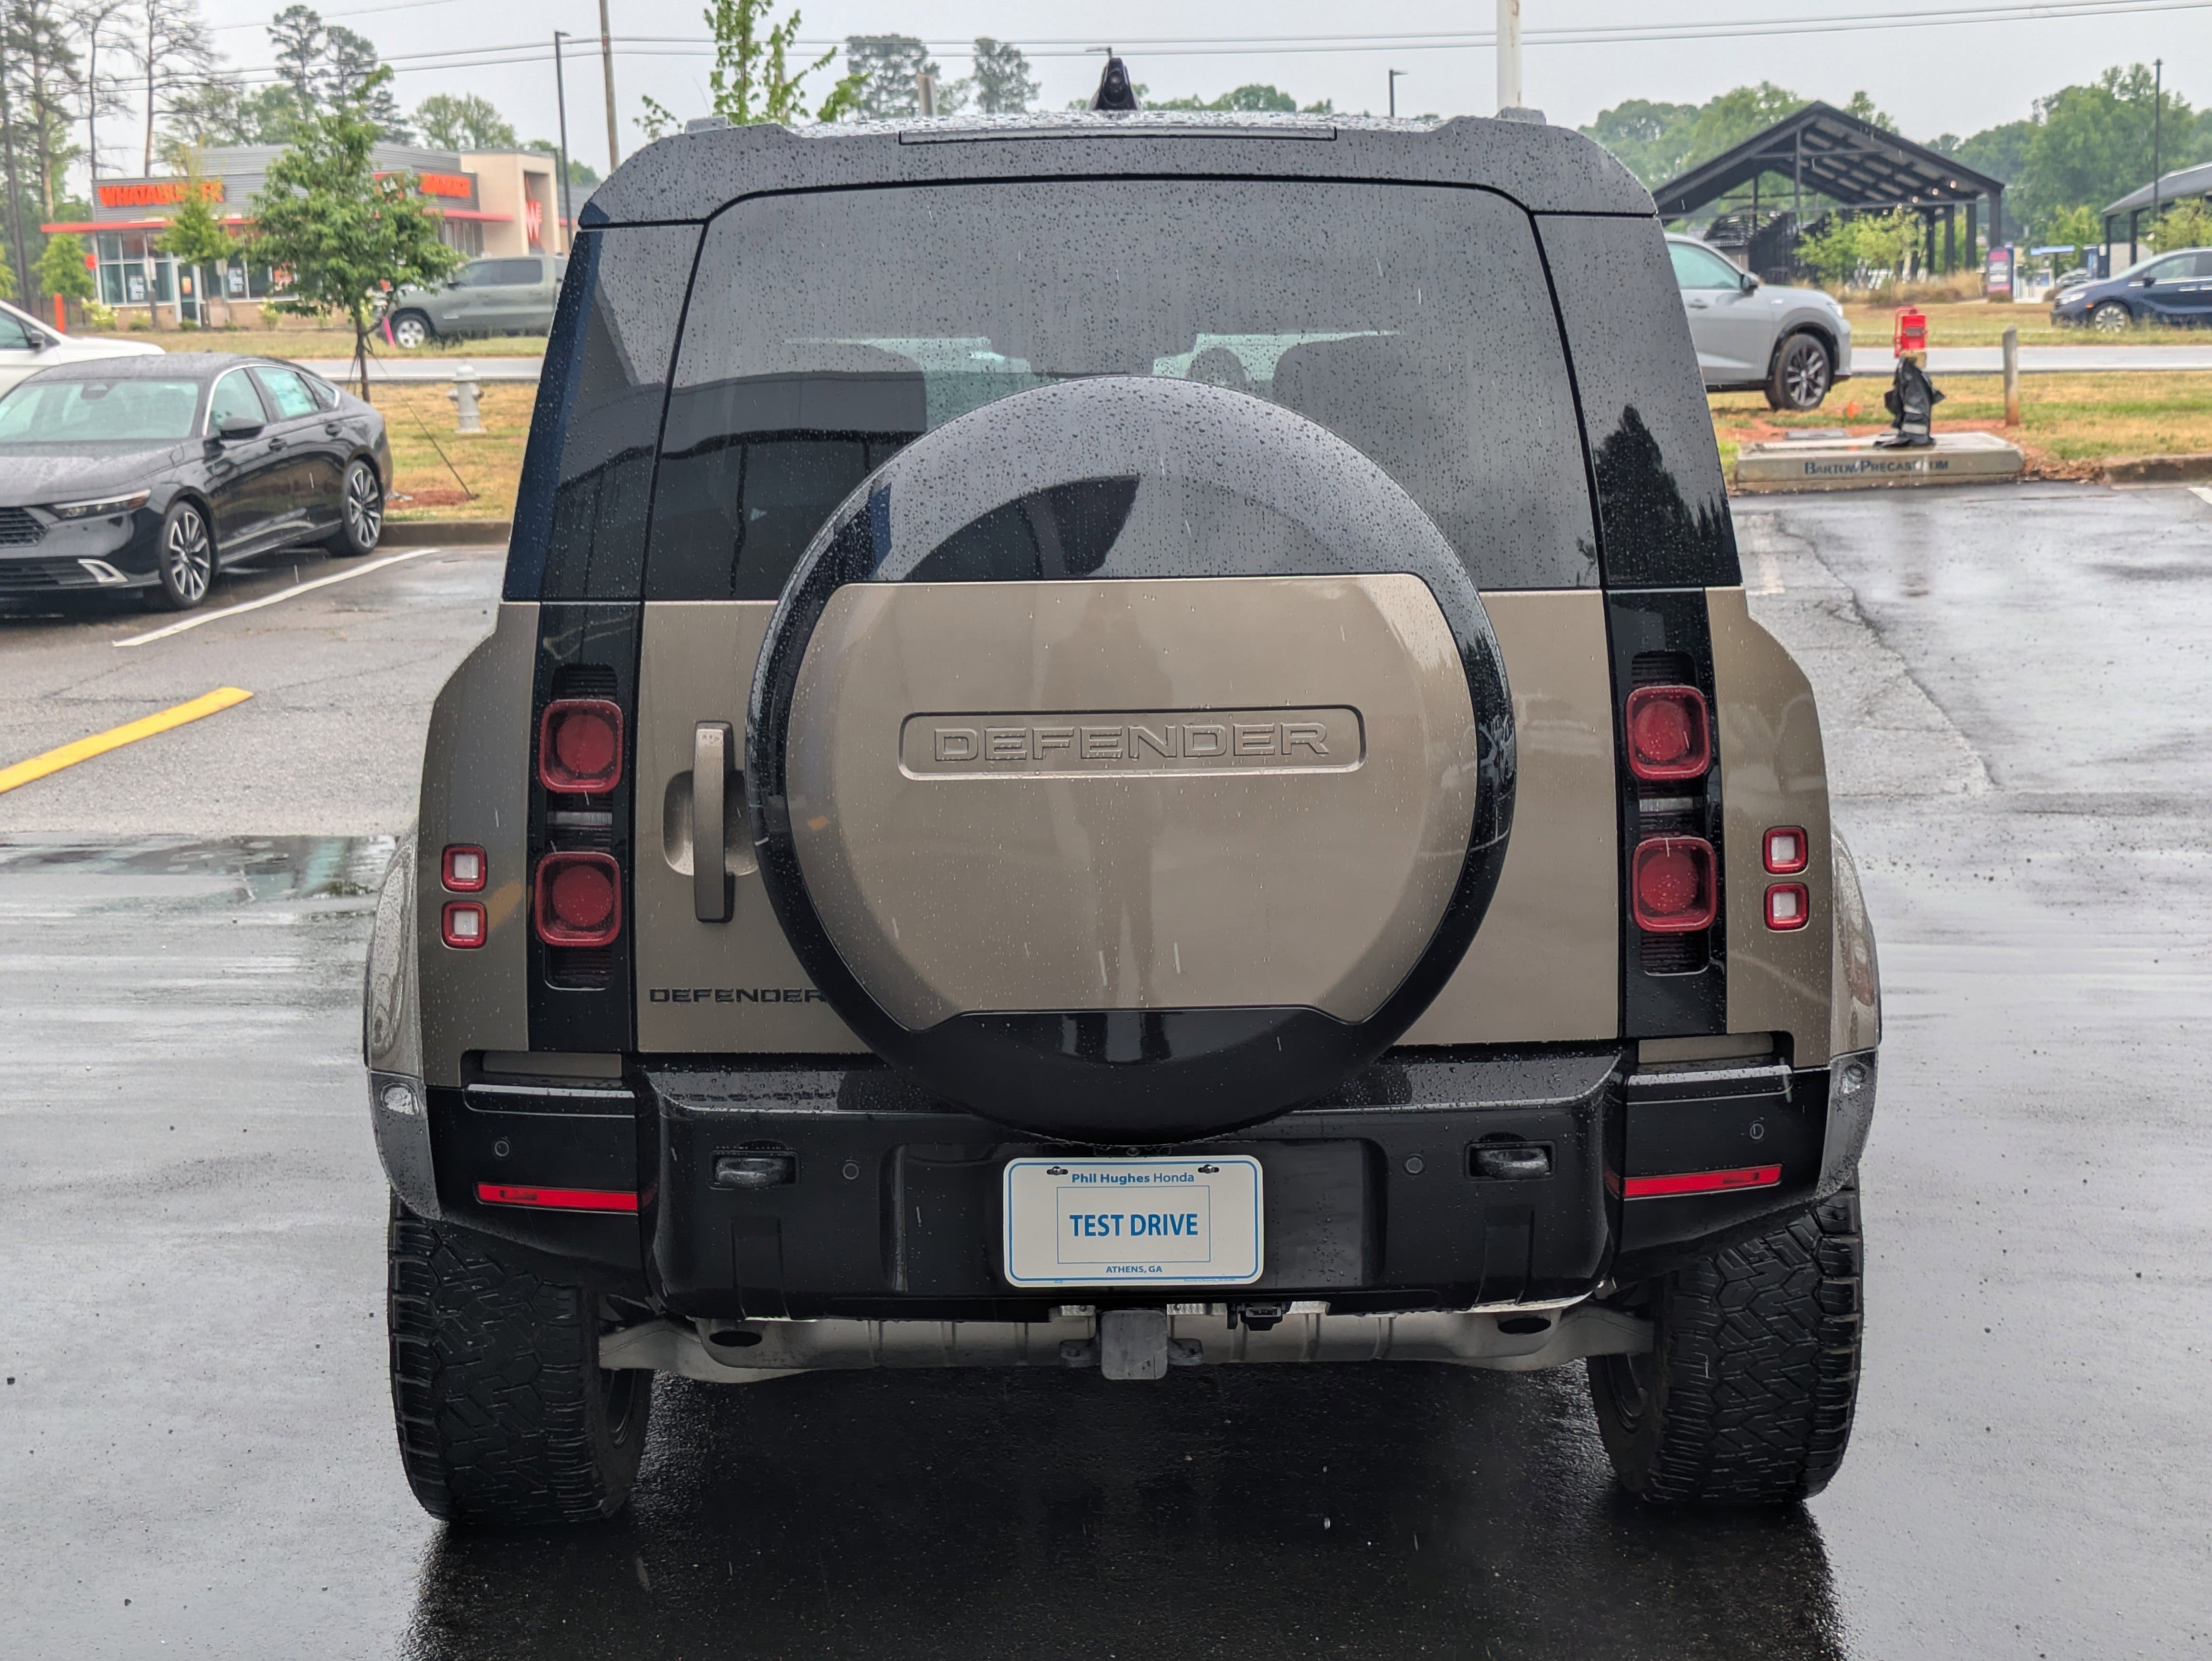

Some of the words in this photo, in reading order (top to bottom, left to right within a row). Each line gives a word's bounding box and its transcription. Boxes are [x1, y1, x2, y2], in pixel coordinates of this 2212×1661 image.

[934, 721, 1330, 762] DEFENDER
[650, 988, 827, 1003] DEFENDER
[1072, 1174, 1096, 1184] Phil
[1100, 1173, 1150, 1185] Hughes
[1153, 1172, 1195, 1183] Honda
[1069, 1214, 1124, 1237] TEST
[1130, 1213, 1198, 1236] DRIVE
[1106, 1265, 1147, 1274] ATHENS,
[1148, 1265, 1162, 1273] GA
